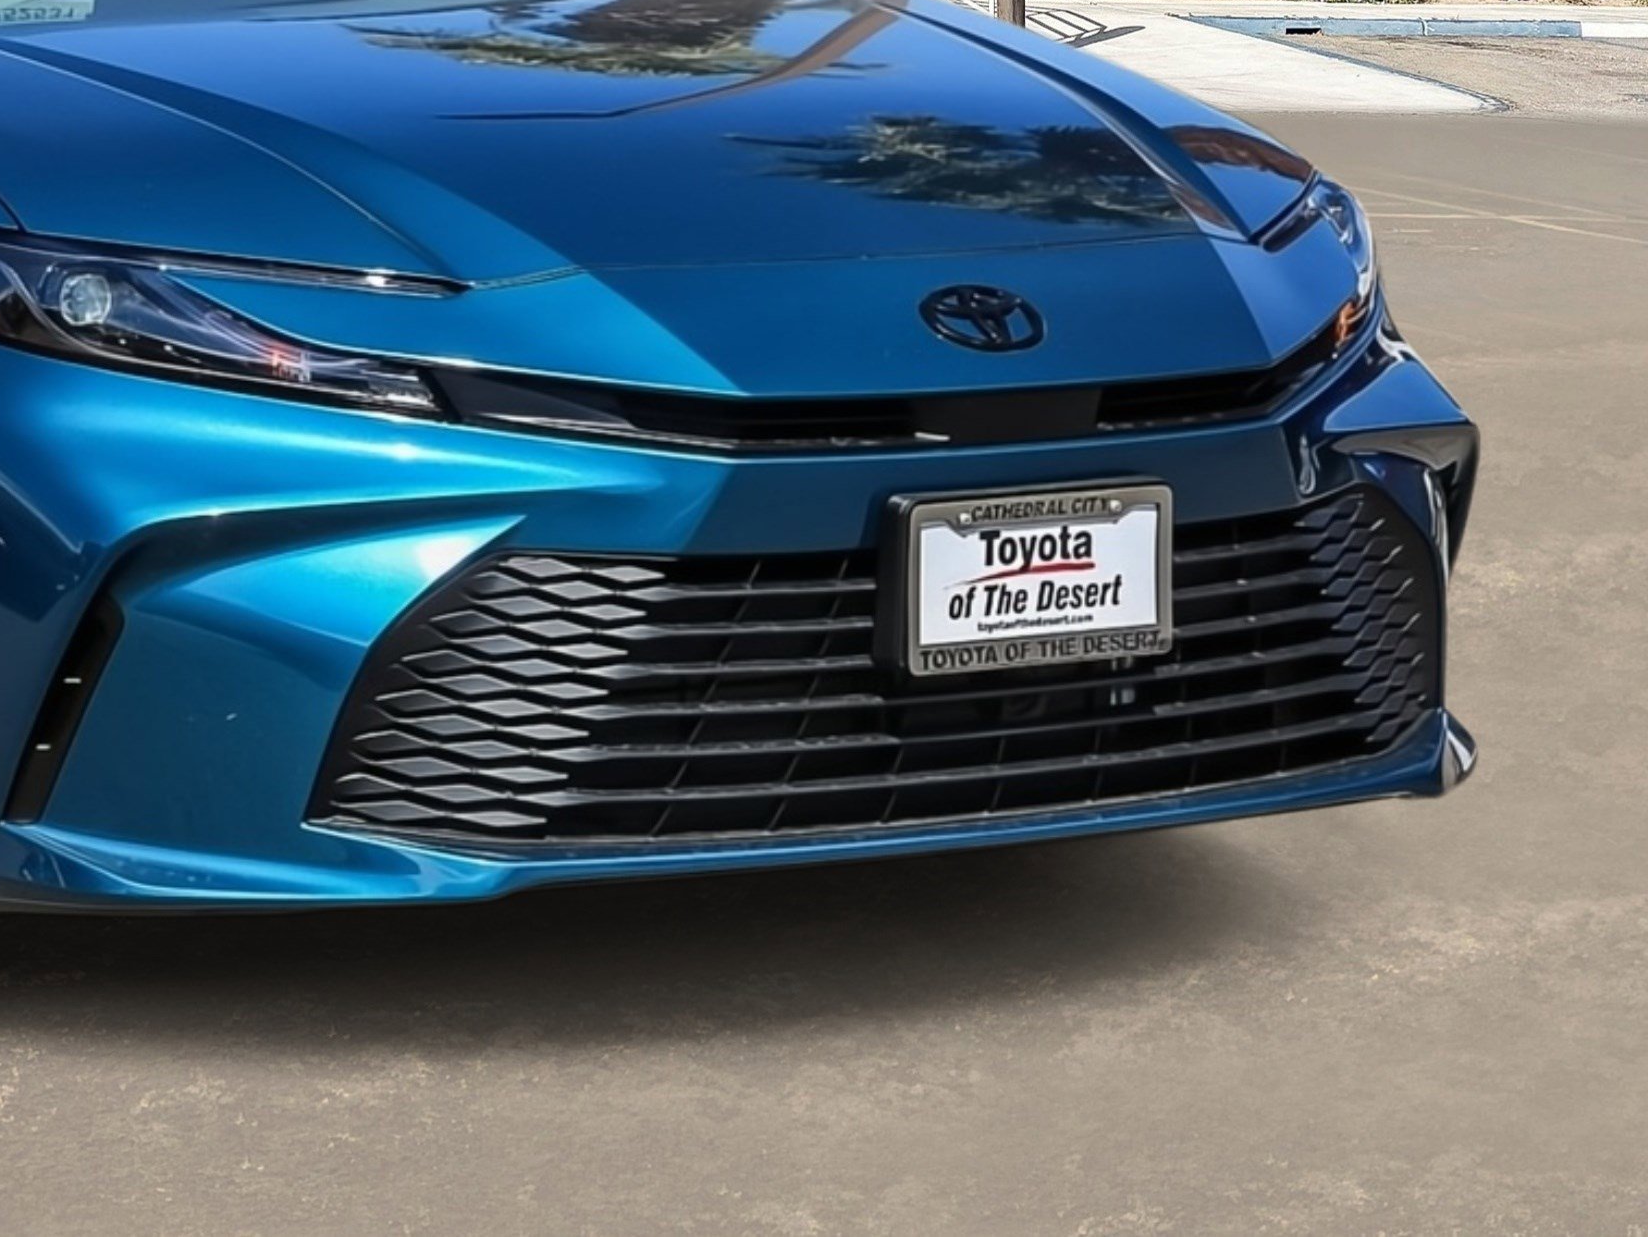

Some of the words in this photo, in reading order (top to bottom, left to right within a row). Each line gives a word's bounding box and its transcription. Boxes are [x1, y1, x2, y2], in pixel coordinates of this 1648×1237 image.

[972, 499, 1066, 521] CATHEDRAL
[1071, 496, 1109, 513] CITY
[979, 525, 1093, 571] Toyota
[949, 586, 977, 620] of
[983, 582, 1028, 617] The
[1036, 574, 1123, 612] Desert
[920, 645, 998, 670] TOYOTA
[1005, 642, 1031, 661] OF
[1036, 636, 1076, 659] THE
[1083, 630, 1160, 653] DESERT
